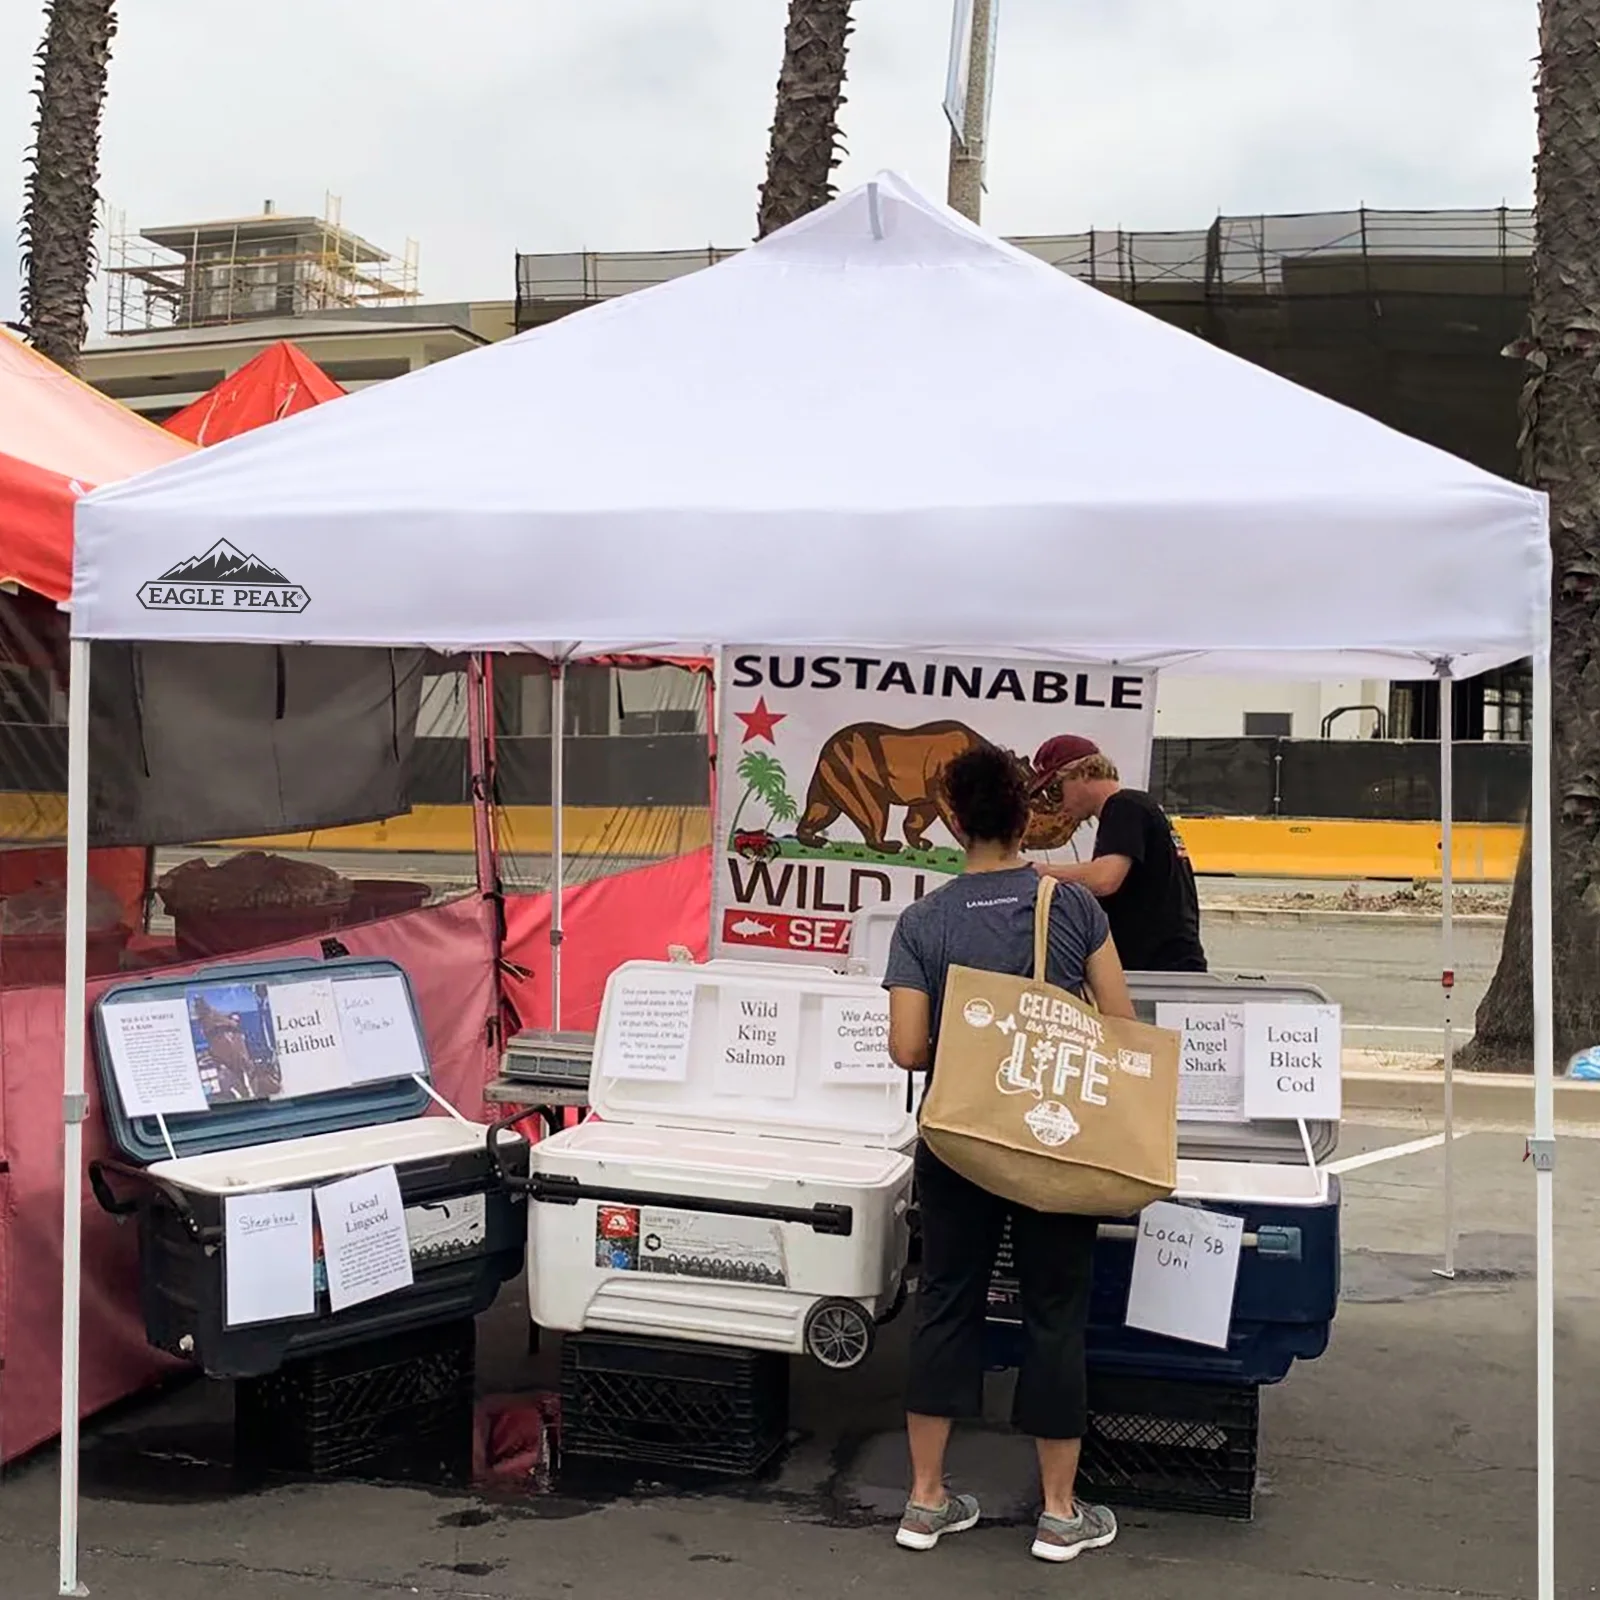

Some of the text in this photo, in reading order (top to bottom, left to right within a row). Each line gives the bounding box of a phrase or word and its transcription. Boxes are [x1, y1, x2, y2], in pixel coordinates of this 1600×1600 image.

[148, 586, 224, 606] EAGLE
[732, 654, 1144, 710] SUSTAINABLE
[728, 858, 892, 913] WILD
[741, 1001, 778, 1018] Wild
[841, 1010, 860, 1022] We
[1019, 992, 1105, 1044] CELEBRATE
[276, 1010, 322, 1031] Local
[1185, 1017, 1226, 1031] Local
[738, 1024, 777, 1046] King
[1267, 1026, 1319, 1044] Local
[276, 1034, 336, 1056] Halibut
[1184, 1038, 1227, 1055] Angel
[725, 1047, 785, 1066] Salmon
[1184, 1058, 1227, 1072] Shark
[1269, 1051, 1323, 1069] Black
[1276, 1076, 1315, 1093] Cod
[350, 1195, 379, 1214] Local
[345, 1208, 389, 1233] Lingcod
[1143, 1221, 1194, 1248] Local
[1204, 1236, 1225, 1255] SB
[1157, 1248, 1188, 1269] Uni
